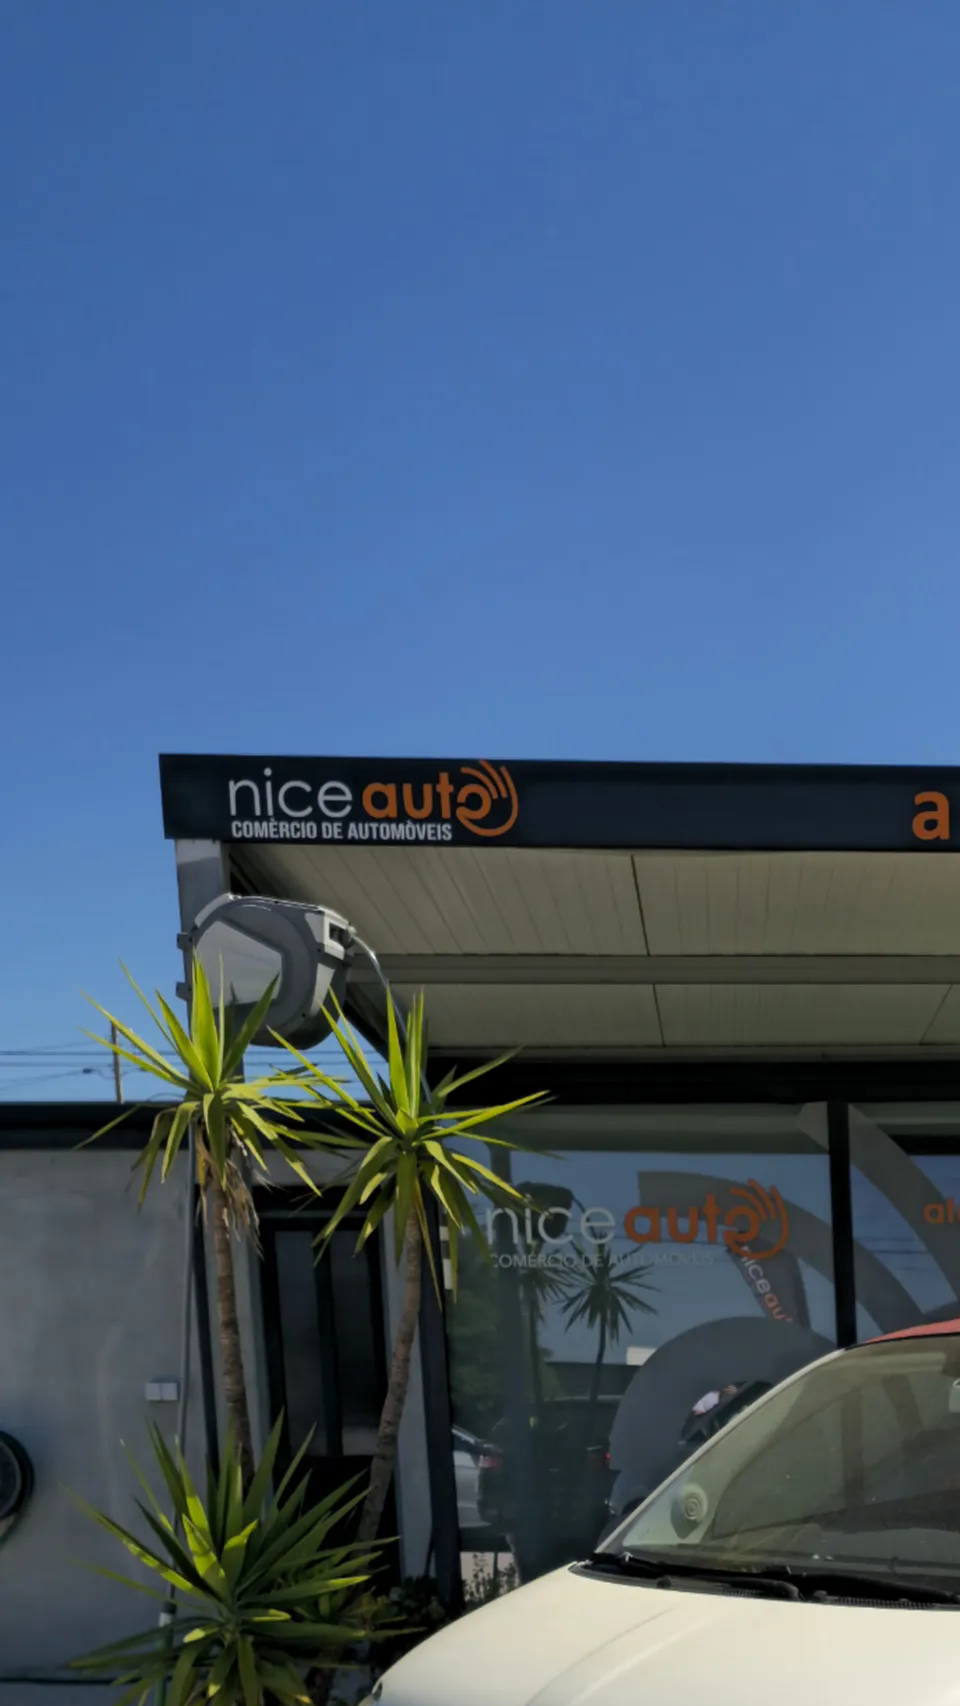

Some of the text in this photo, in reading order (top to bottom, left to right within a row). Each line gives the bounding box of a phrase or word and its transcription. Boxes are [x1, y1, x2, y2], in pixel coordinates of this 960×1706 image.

[229, 767, 353, 818] nice
[911, 790, 951, 841] a
[322, 821, 344, 840] DE
[484, 1193, 616, 1246] nice
